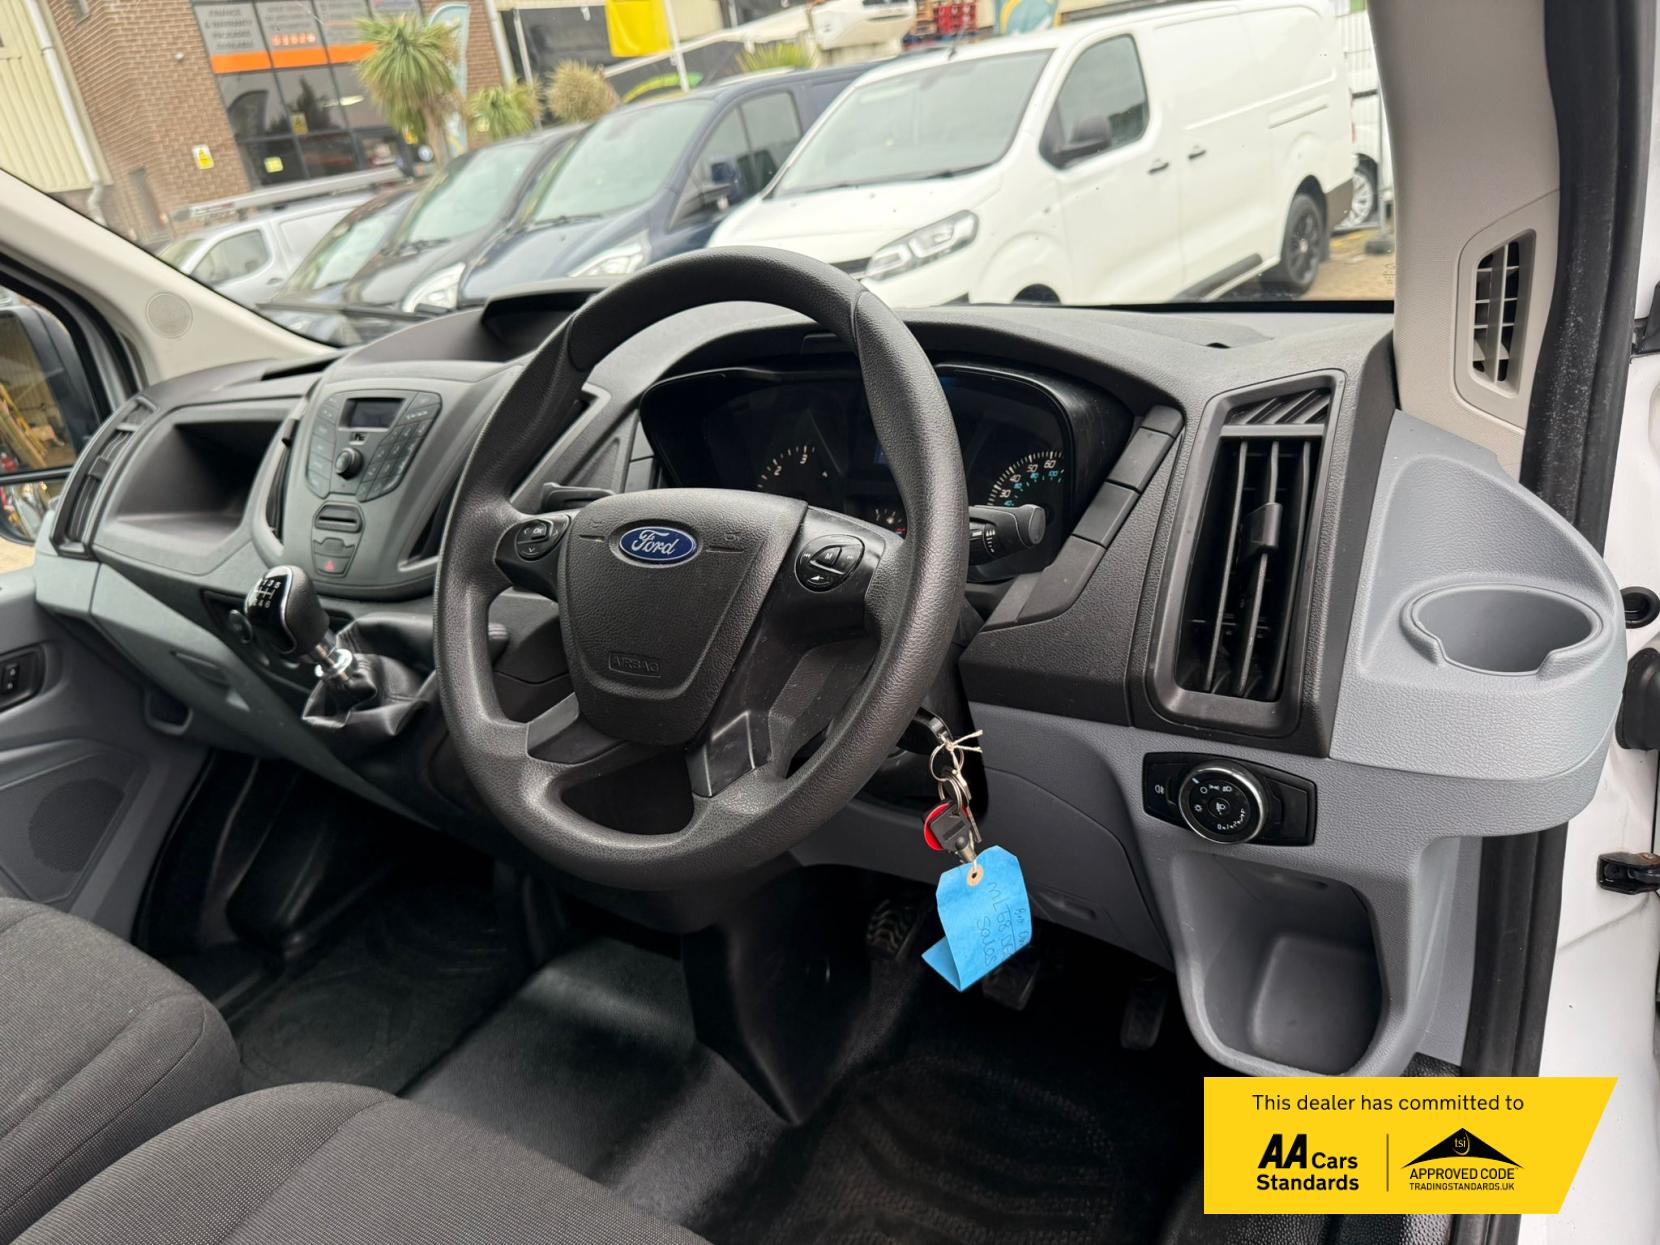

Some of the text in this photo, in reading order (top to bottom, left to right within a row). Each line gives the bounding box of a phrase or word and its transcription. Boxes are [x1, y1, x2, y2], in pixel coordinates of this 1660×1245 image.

[774, 454, 808, 476] 2 3
[999, 460, 1056, 498] 30 40 50 60
[631, 529, 680, 555] Ford
[824, 552, 833, 561] M
